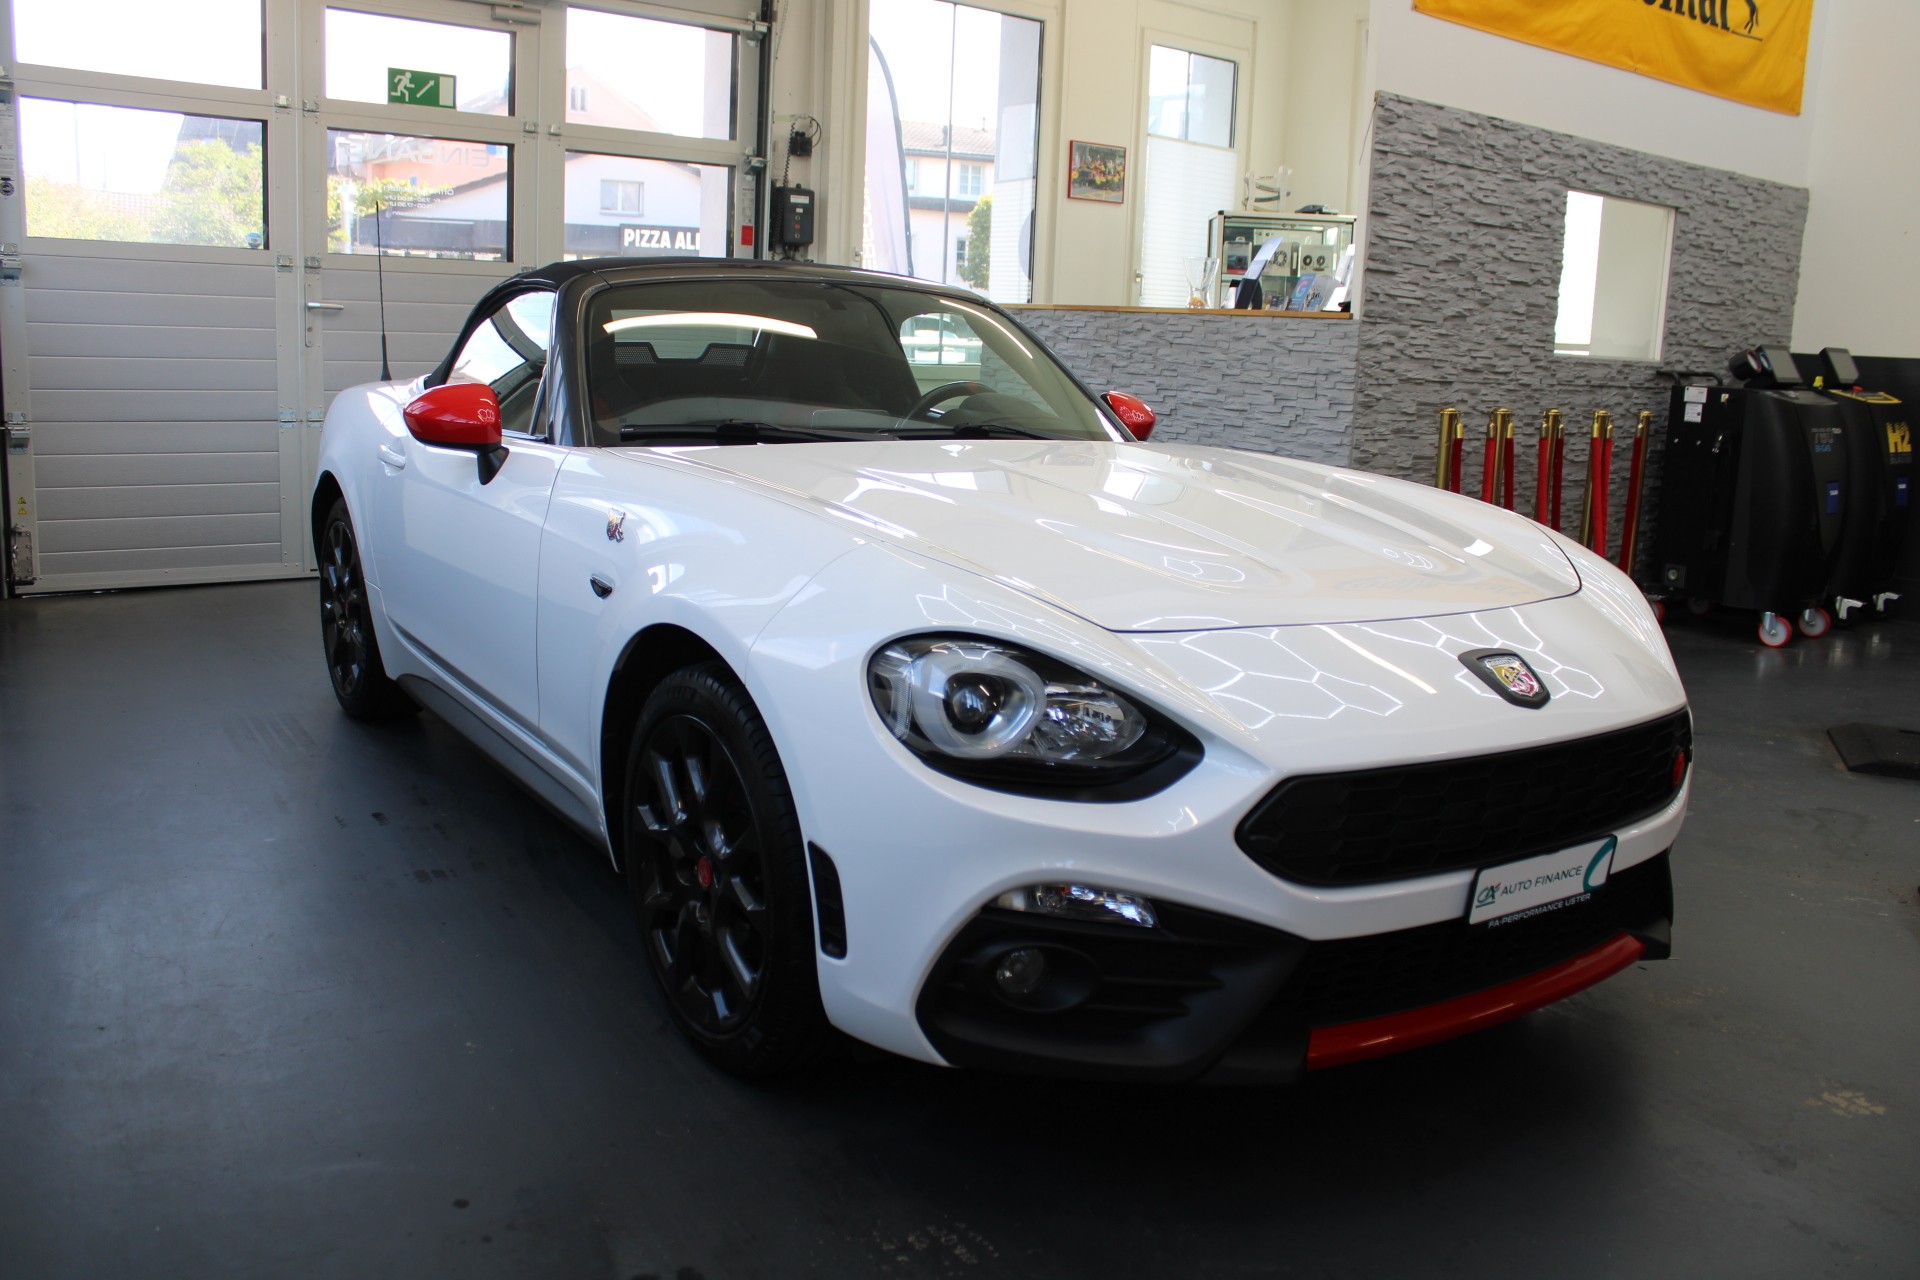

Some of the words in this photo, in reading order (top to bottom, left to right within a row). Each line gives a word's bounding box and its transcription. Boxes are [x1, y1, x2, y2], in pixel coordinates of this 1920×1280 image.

[623, 228, 671, 248] PIZZA
[1500, 879, 1532, 897] AUTO
[1534, 865, 1583, 887] FINANCE
